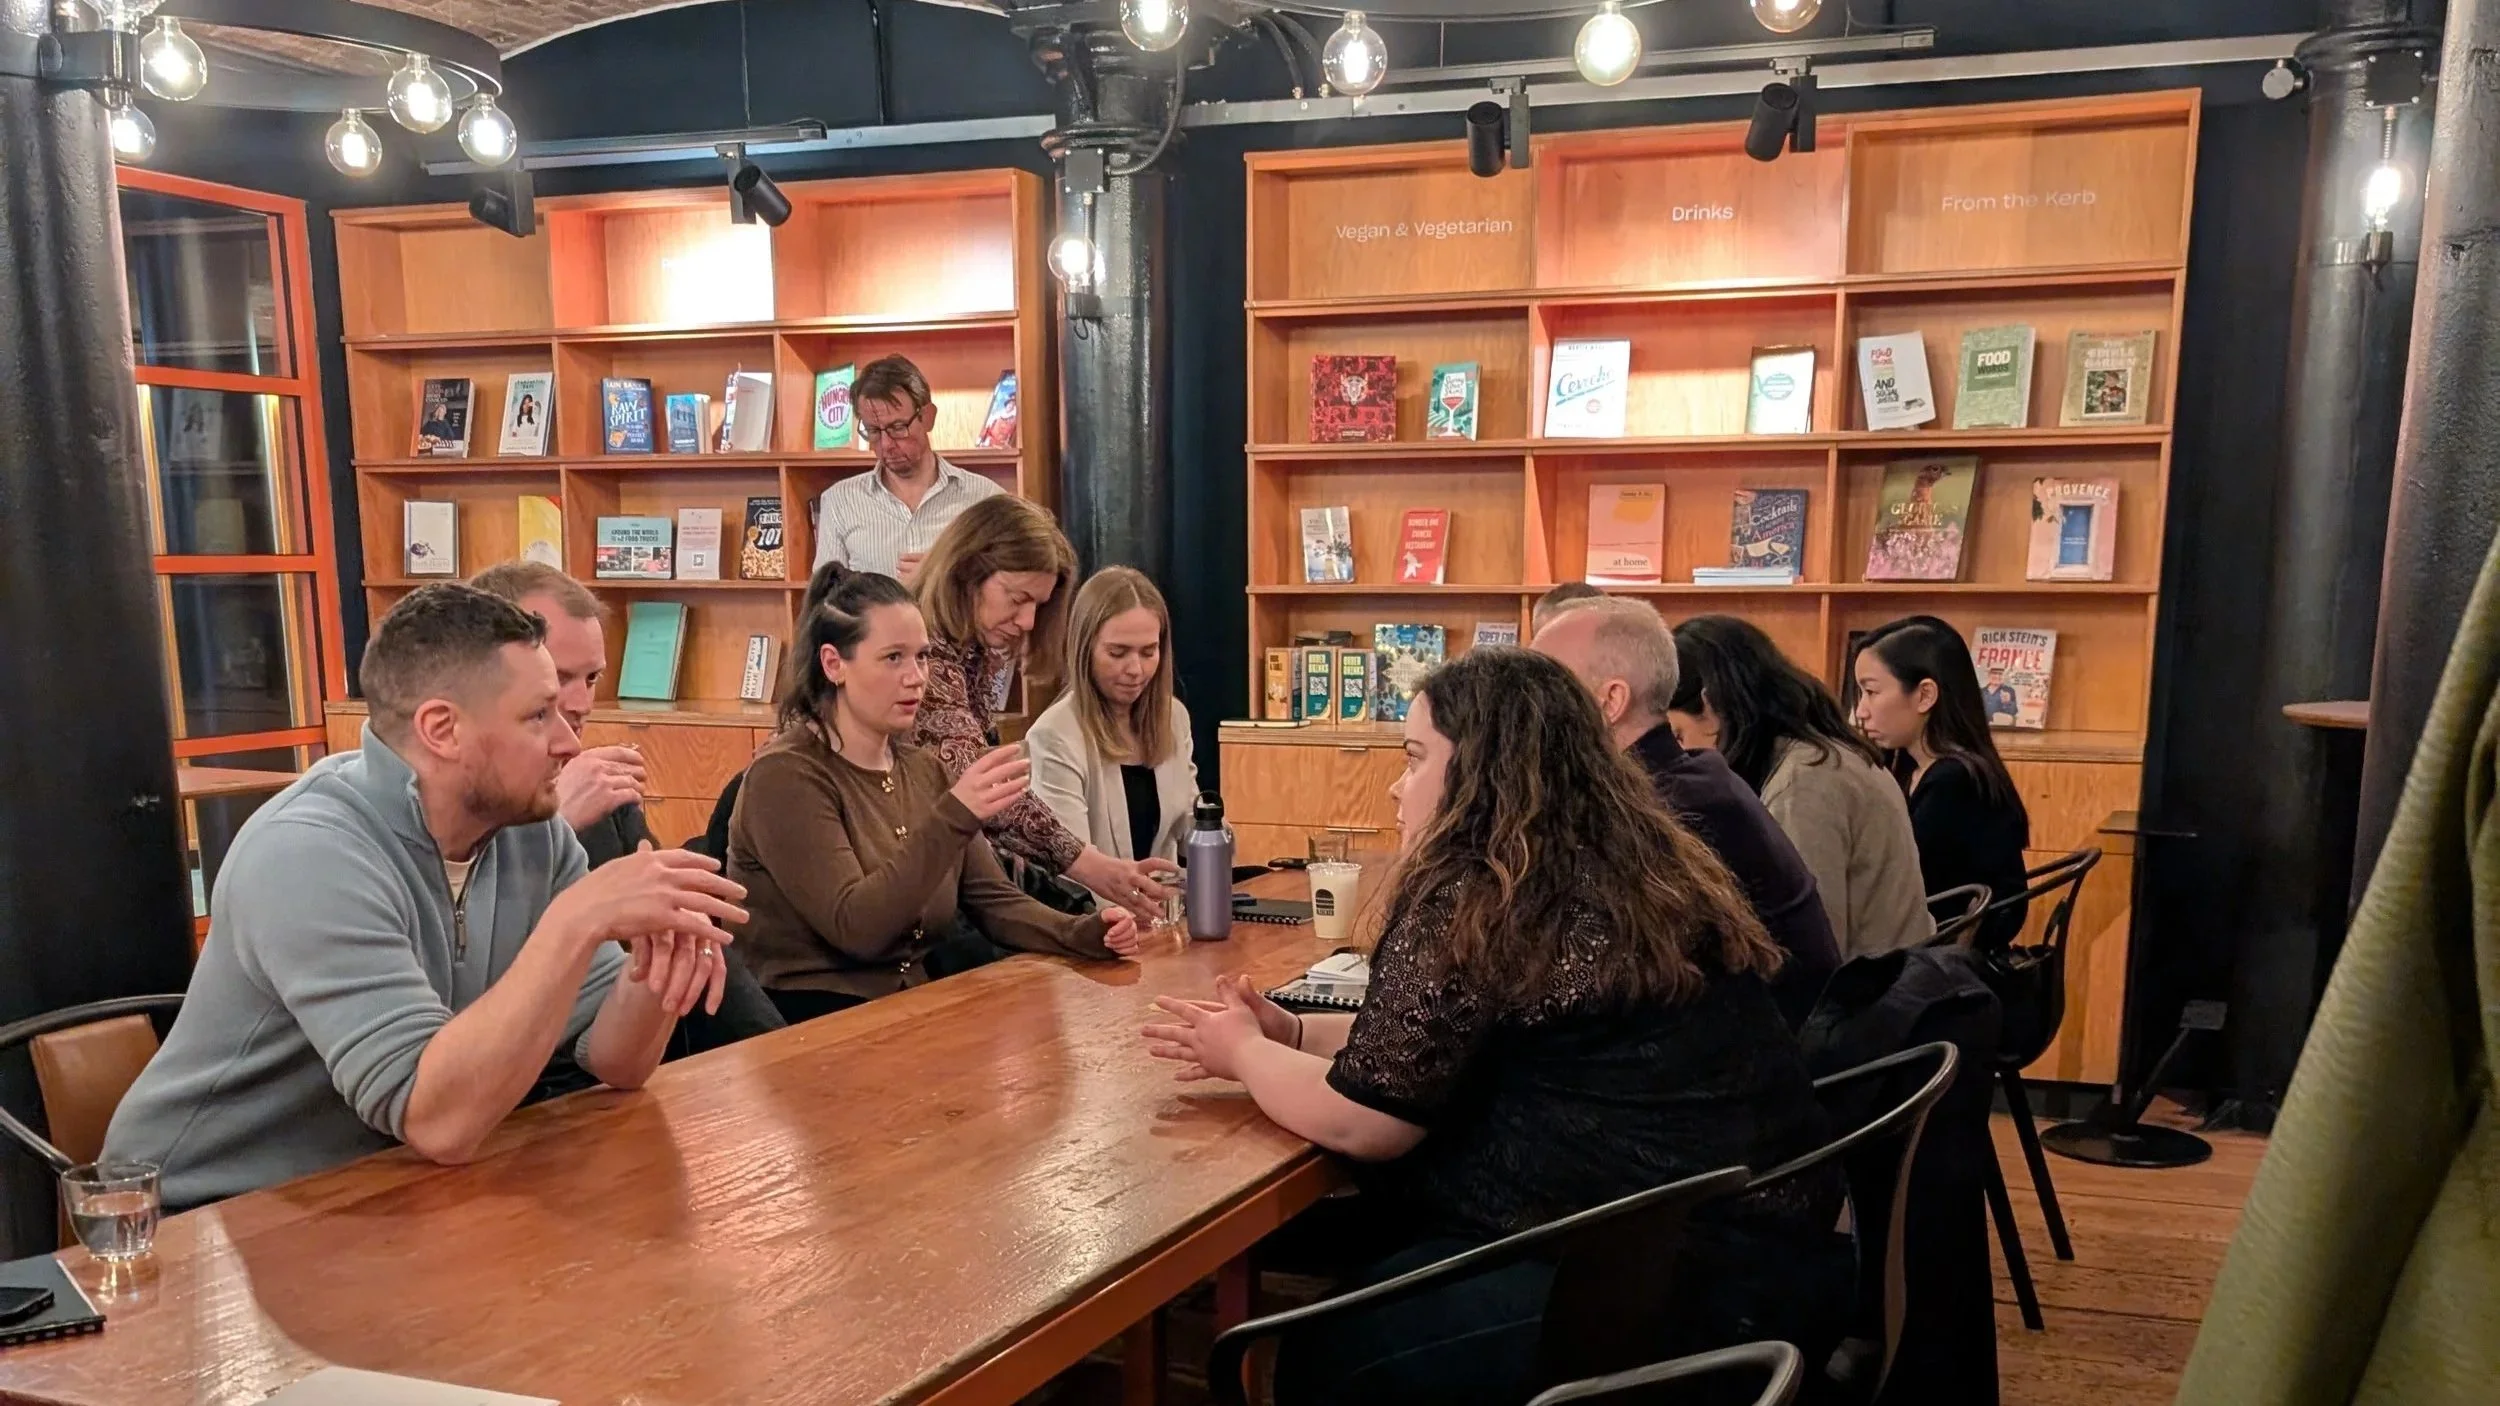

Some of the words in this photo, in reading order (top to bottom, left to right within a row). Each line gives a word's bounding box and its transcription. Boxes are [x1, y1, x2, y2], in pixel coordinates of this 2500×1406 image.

[1942, 196, 1996, 212] From
[2003, 193, 2038, 209] the
[2046, 189, 2096, 207] Kerb
[1672, 203, 1734, 221] Drinks
[1336, 224, 1390, 243] Vegan
[1395, 222, 1409, 237] &
[1414, 218, 1512, 240] Vegetarian
[1977, 350, 2012, 367] FOOD
[1874, 377, 1896, 390] AND
[611, 400, 638, 417] RAW
[828, 406, 844, 423] CITY
[610, 407, 648, 428] SPIRIT
[2046, 483, 2111, 499] PROVENCE
[760, 514, 783, 523] THUG
[1750, 499, 1799, 526] Cocktails
[757, 528, 783, 546] 101
[1613, 558, 1622, 567] at
[1624, 556, 1648, 567] home
[1477, 630, 1499, 644] SUPER
[1981, 631, 2007, 645] RICK
[2008, 631, 2049, 647] STEIN'S
[1976, 647, 2045, 672] FRANCE
